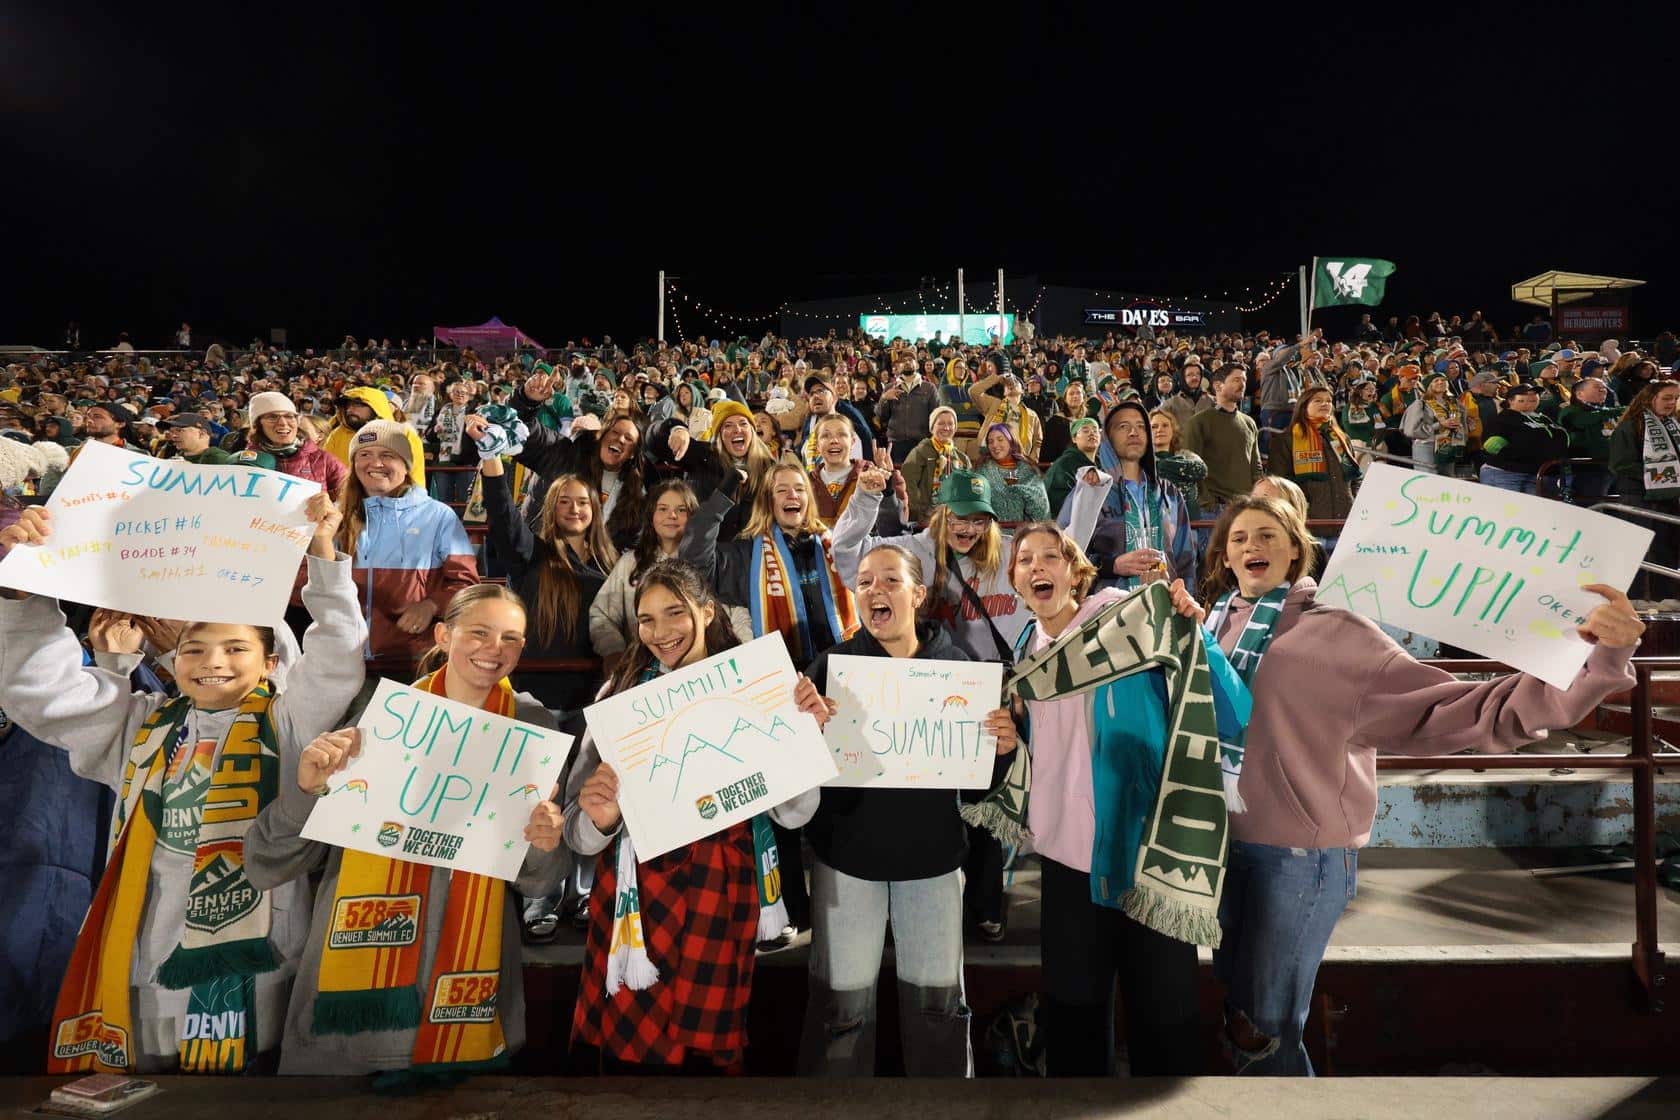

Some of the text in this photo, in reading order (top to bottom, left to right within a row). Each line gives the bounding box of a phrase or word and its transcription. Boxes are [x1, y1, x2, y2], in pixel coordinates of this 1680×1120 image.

[1563, 318, 1623, 329] HEADQUARTERS
[120, 460, 302, 503] SUMMIT
[114, 519, 169, 536] PICKET
[1391, 474, 1582, 563] Summit
[1407, 548, 1525, 632] UP!!
[632, 658, 743, 726] SUMMIT!
[872, 716, 982, 763] SUMMIT!
[399, 765, 489, 828] UP!
[715, 771, 766, 801] TOGETHER
[721, 783, 769, 813] WE CLIMB
[402, 838, 422, 856] WE
[422, 842, 458, 861] CLIMB
[406, 826, 464, 850] TOGETHER
[190, 901, 244, 919] SUMMIT
[208, 912, 226, 924] FC
[333, 930, 363, 944] DENVER
[367, 929, 398, 942] SUMMIT
[434, 1006, 467, 1019] DENVER
